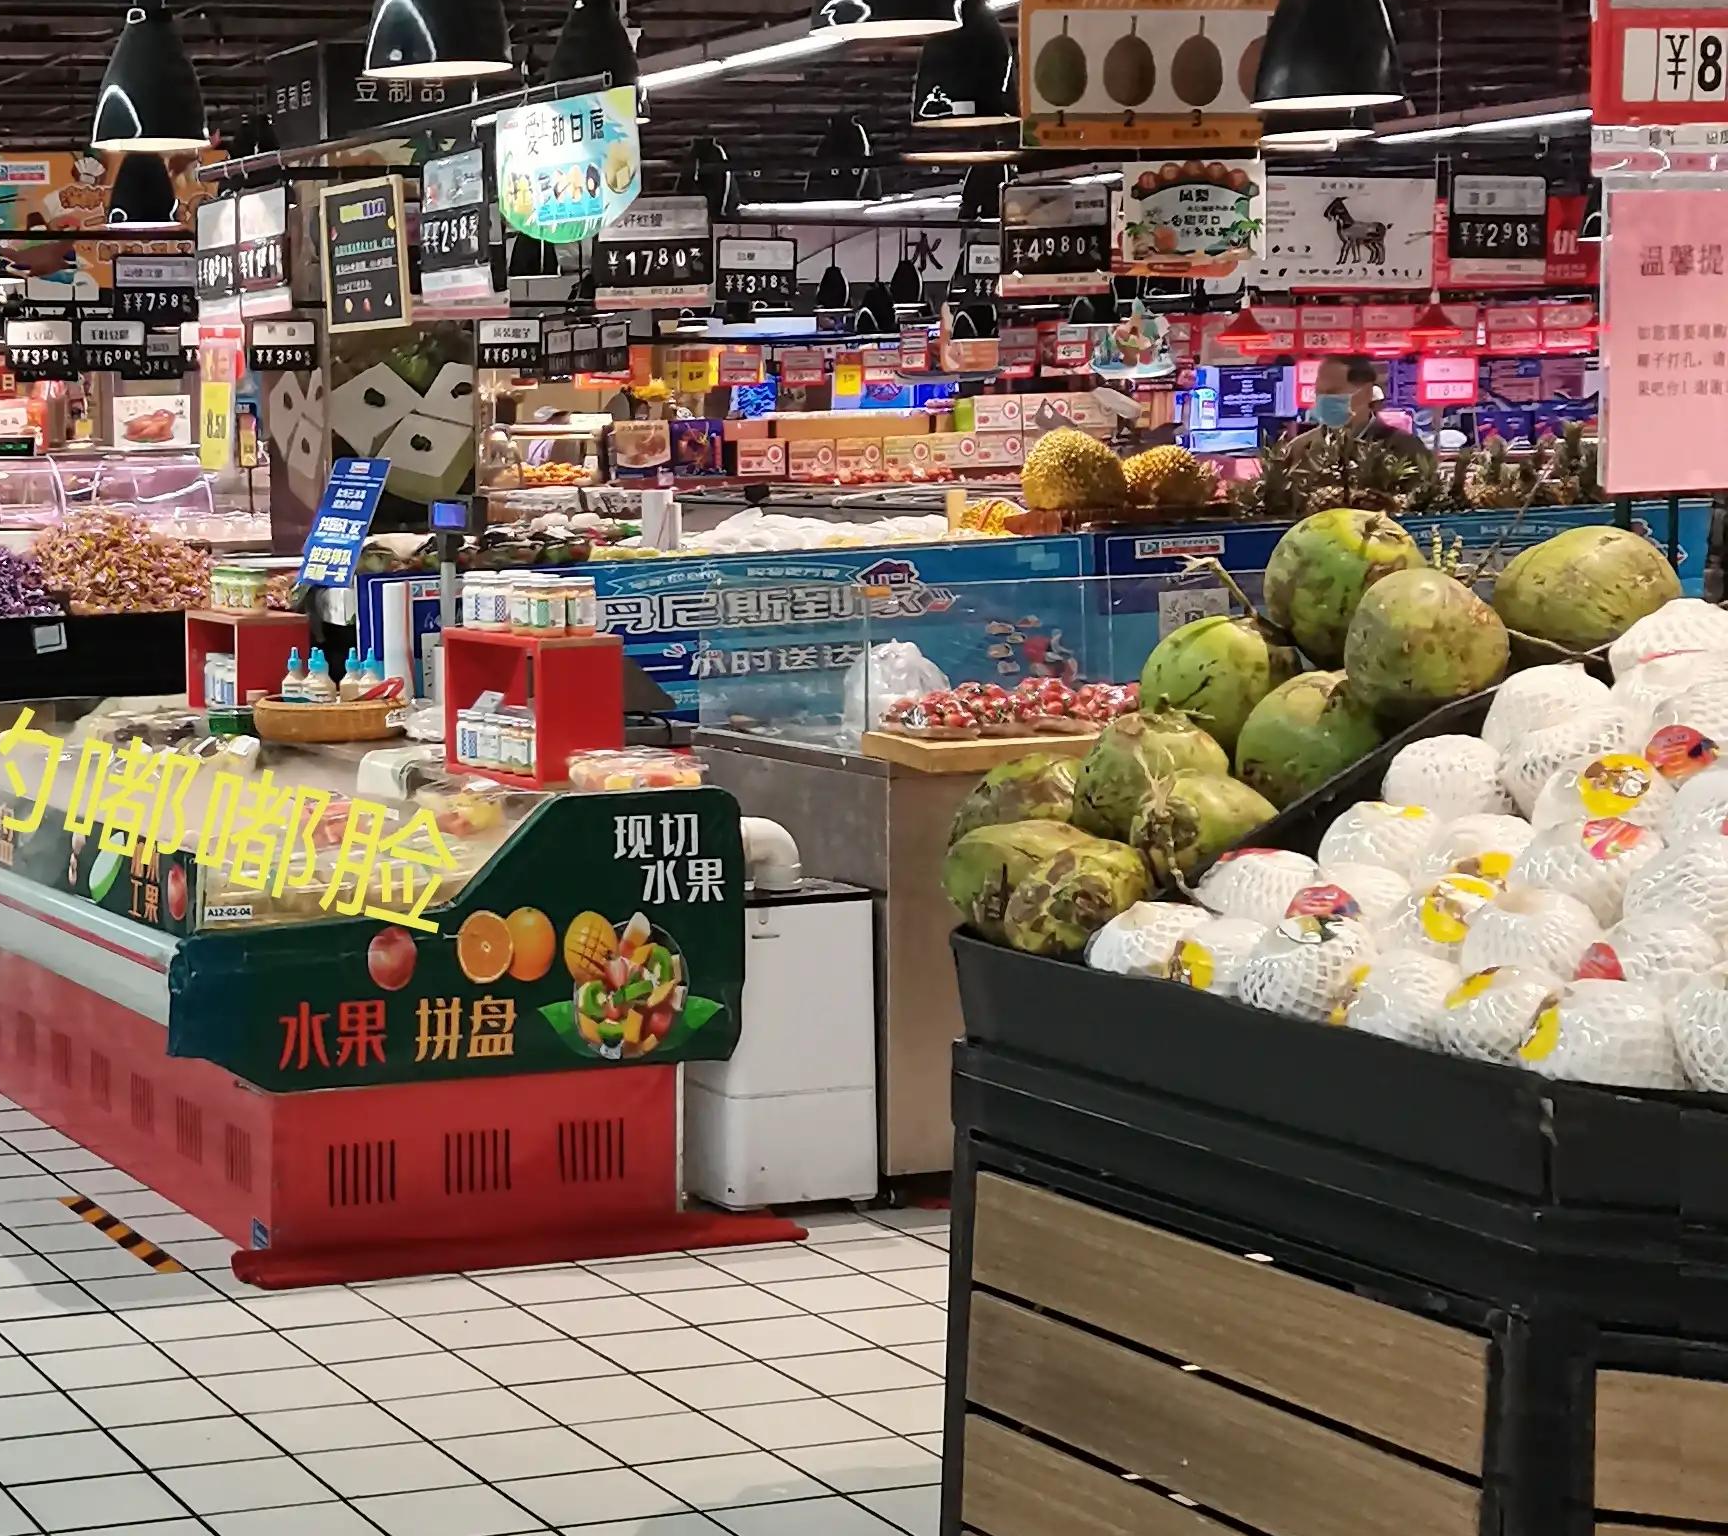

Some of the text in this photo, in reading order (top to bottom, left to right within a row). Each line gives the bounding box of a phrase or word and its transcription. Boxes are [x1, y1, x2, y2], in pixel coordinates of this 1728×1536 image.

[352, 76, 446, 104] 豆制品
[596, 560, 929, 635] 丹尼斯到家
[612, 812, 701, 862] 现切
[640, 857, 726, 906] 水果
[279, 993, 518, 1070] 水果 拼盘
